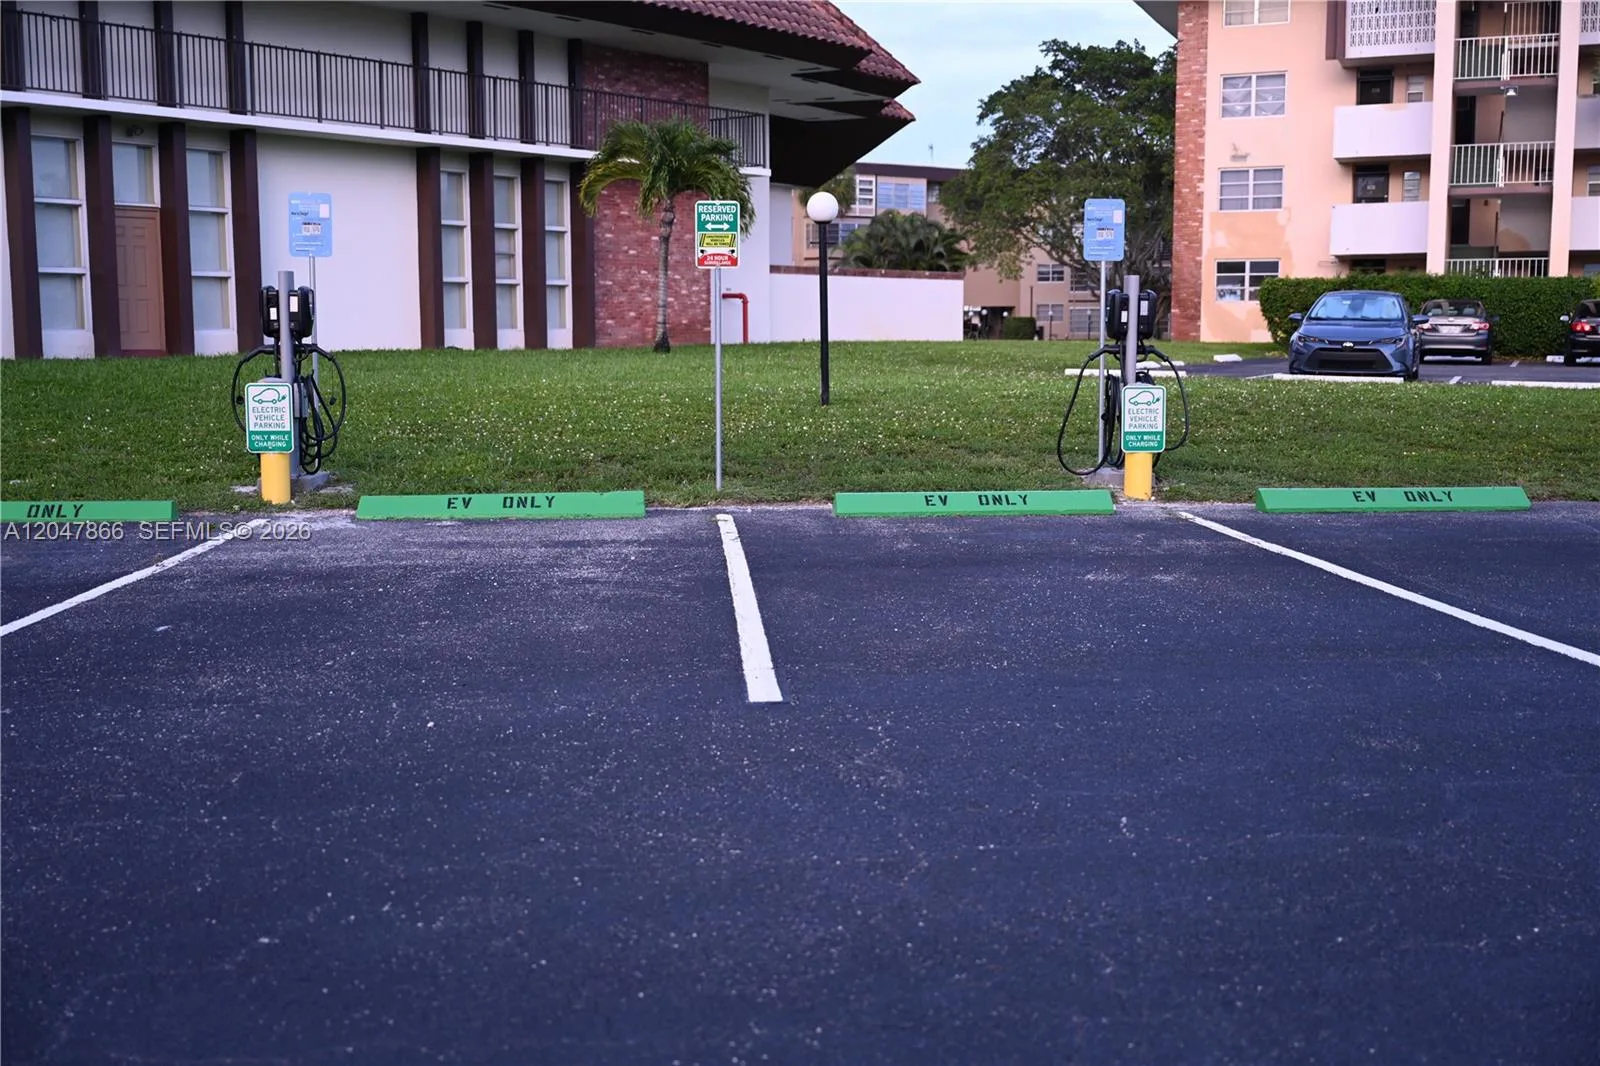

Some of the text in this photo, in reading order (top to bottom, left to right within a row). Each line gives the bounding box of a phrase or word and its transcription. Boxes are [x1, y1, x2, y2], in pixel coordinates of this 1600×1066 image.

[698, 205, 737, 213] RESERVED
[252, 406, 286, 414] ELECTRIC
[447, 495, 556, 509] EV ONLY
[924, 494, 1028, 506] EV ONLY
[1352, 490, 1453, 502] EV ONLY
[26, 504, 84, 519] ONLY
